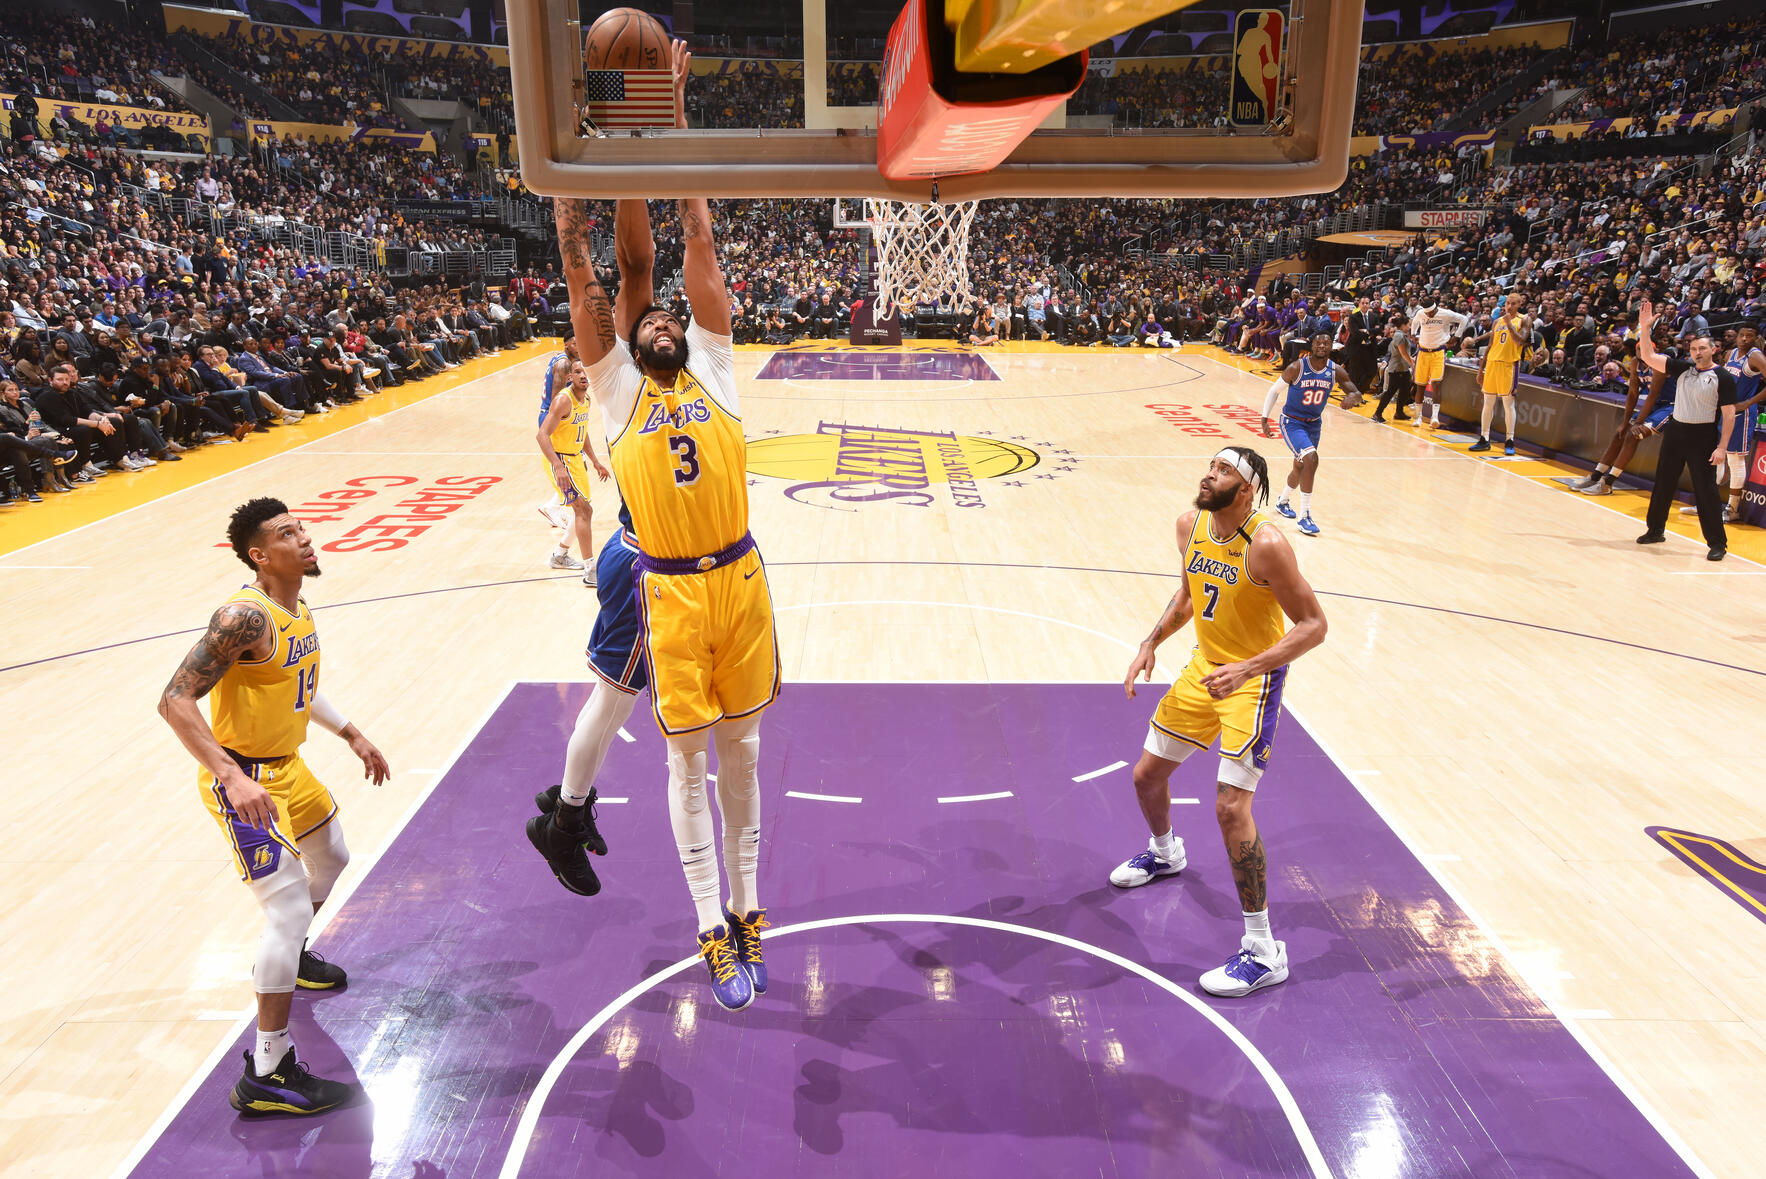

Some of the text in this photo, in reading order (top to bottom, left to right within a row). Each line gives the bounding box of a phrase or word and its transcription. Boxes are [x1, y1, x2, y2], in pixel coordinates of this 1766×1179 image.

[86, 107, 121, 121] LOS
[124, 112, 208, 129] ANGELES
[1237, 102, 1258, 120] NBA
[1500, 332, 1507, 344] 0
[1300, 379, 1332, 389] NEW YORK
[1302, 389, 1325, 406] 30
[638, 397, 711, 434] LAERS
[1144, 403, 1234, 439] Center
[1471, 391, 1556, 432] TSOT
[575, 424, 586, 443] 11
[668, 434, 701, 488] 3
[783, 420, 958, 512] LAKERS
[937, 442, 986, 509] LOS ANGELES
[321, 475, 503, 553] STAPLES
[1186, 550, 1239, 585] LAKERS
[1201, 582, 1220, 622] 7
[294, 662, 317, 713] 14
